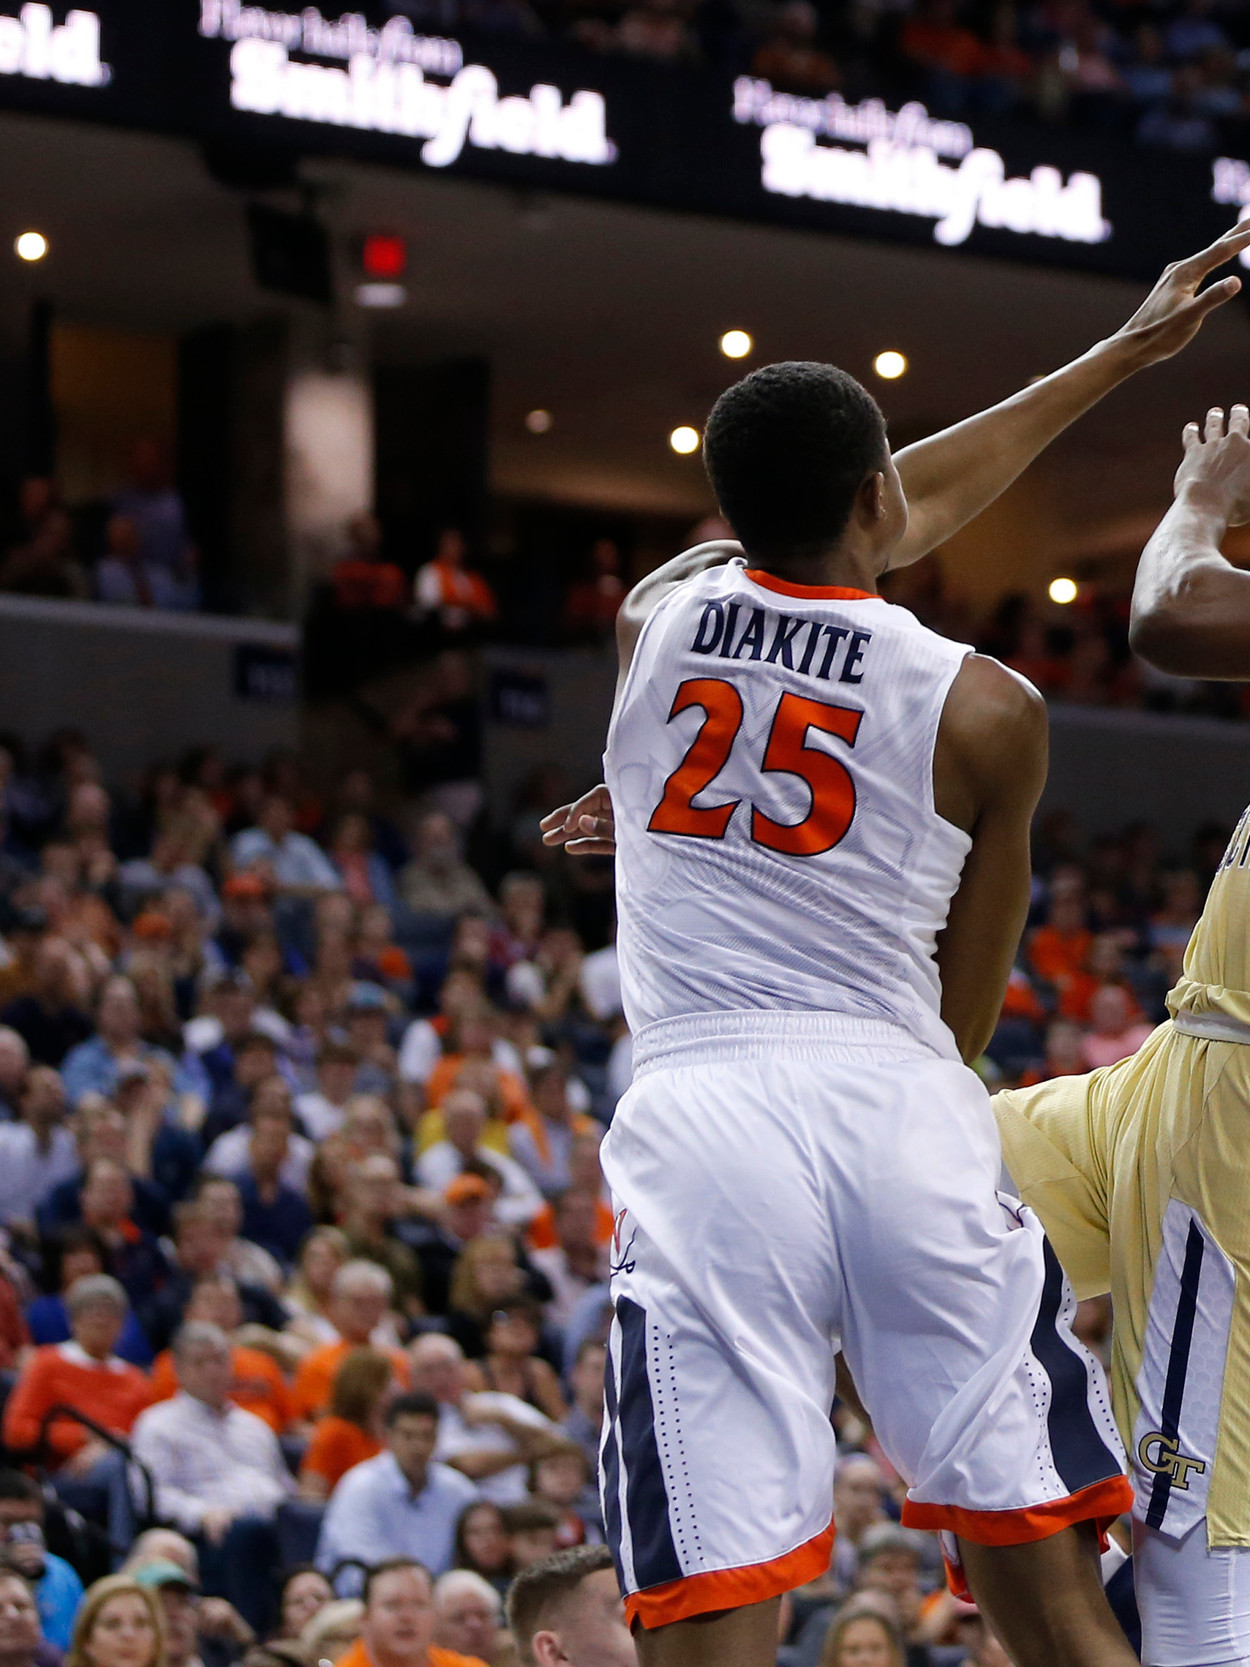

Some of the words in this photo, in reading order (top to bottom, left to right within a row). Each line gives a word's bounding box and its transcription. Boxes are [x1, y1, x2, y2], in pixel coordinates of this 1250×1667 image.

[690, 601, 872, 684] DIAKITE
[646, 677, 864, 857] 25
[1138, 1431, 1205, 1490] GT
